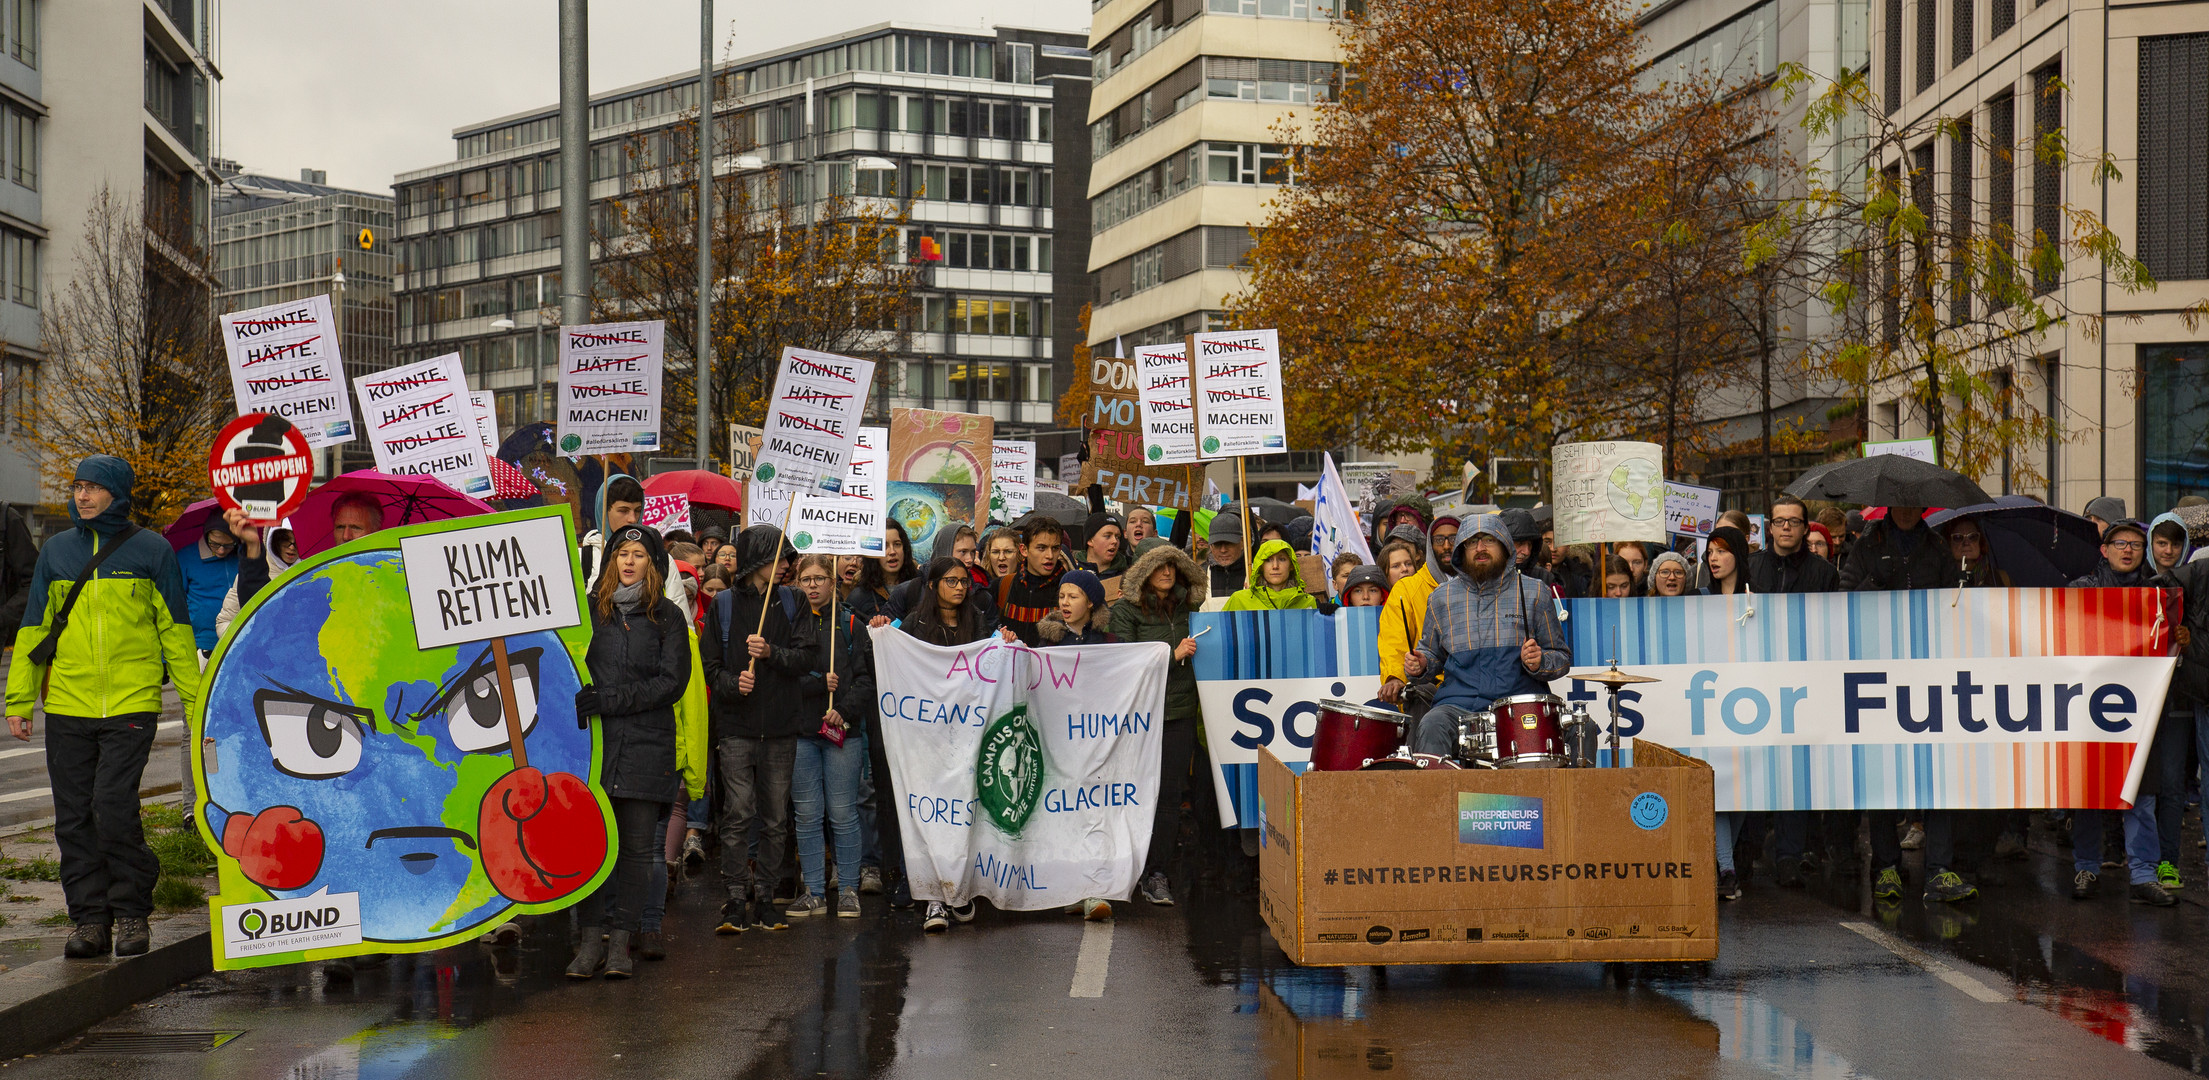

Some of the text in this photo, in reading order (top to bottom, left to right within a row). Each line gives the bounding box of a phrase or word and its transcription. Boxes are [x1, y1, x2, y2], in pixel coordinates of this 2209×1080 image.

[248, 342, 317, 363] HÄTTE.
[577, 356, 641, 372] HÄTTE.
[1210, 363, 1263, 378] HÄTTE.
[249, 365, 329, 395] WOLLTE.
[572, 380, 647, 399] WOLLTE.
[1151, 374, 1190, 388] HÄTT
[788, 385, 844, 411] HÄTTE.
[1207, 386, 1270, 404] WOLLTE.
[382, 400, 451, 425] HÄTTE.
[569, 409, 648, 422] MACHEN!
[909, 408, 980, 435] STOP
[1208, 413, 1273, 425] MACHEN!
[779, 415, 844, 434] WOLLTE.
[386, 422, 464, 456] WOLLTE.
[769, 438, 840, 465] MACHEN!
[1564, 444, 1587, 458] SEHT
[1593, 442, 1616, 455] NUR
[212, 456, 308, 488] KOHLE STOPPEN!
[1570, 456, 1601, 473] GELD
[998, 475, 1028, 484] OLLTE.
[1580, 478, 1595, 492] MIT
[1003, 490, 1028, 500] CHEN!
[1664, 484, 1699, 500] Donalds
[752, 507, 772, 522] NO
[801, 508, 874, 526] MACHEN!
[443, 536, 530, 587] KLIMA
[437, 575, 552, 631] RETTEN!
[879, 691, 988, 728] OCEANS
[1684, 669, 1808, 736] for
[1842, 670, 2138, 735] Future
[1067, 711, 1151, 741] HUMAN
[982, 725, 1013, 787] CAMPUS
[1027, 759, 1038, 800] STUTTGART
[1044, 782, 1140, 814] GLACIER
[908, 793, 980, 827] FOREST
[1460, 810, 1539, 820] ENTREPRENEURS
[1472, 821, 1532, 831] FOR FUTURE
[973, 851, 1048, 890] ANIMAL
[1323, 861, 1693, 886] #ENTREPRENEURSFORFUTURE
[270, 907, 340, 934] BUND
[240, 932, 342, 952] FRIENDS OF THE EARTH GERMANY
[1401, 932, 1427, 941] demeter
